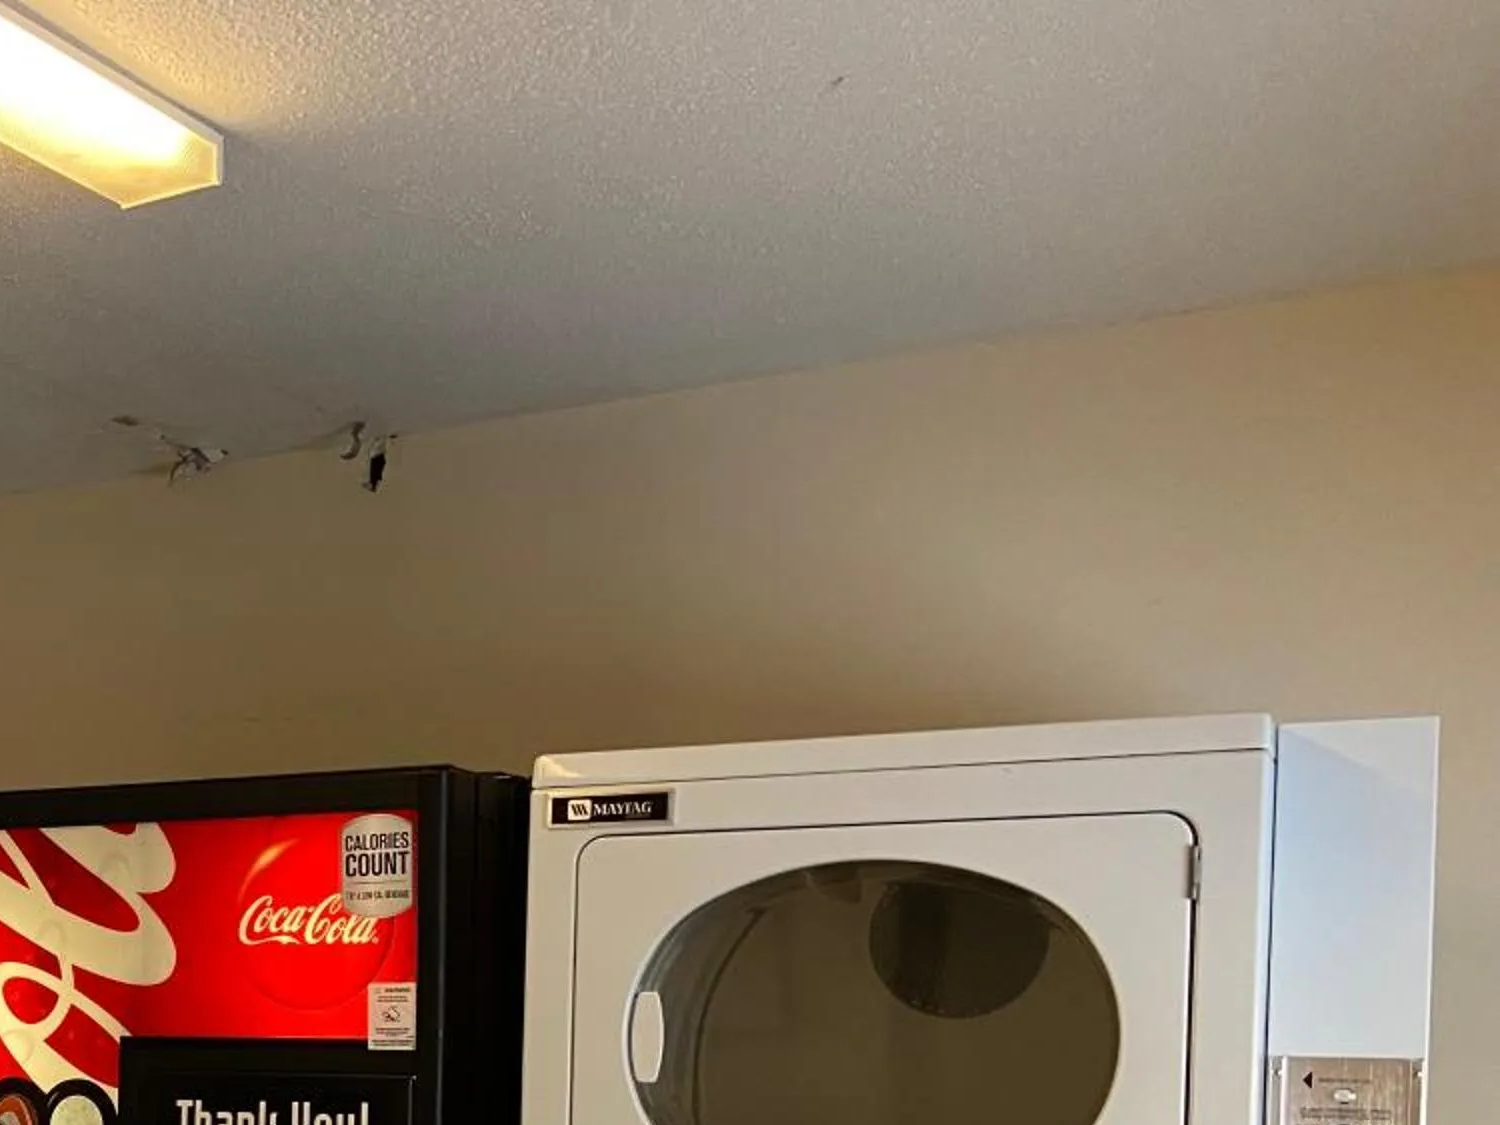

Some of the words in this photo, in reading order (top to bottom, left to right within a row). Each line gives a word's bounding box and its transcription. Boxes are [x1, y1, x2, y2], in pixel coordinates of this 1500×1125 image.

[593, 801, 653, 816] MAYTAG
[345, 831, 409, 852] CALORIES
[345, 851, 409, 877] COUNT
[238, 893, 379, 945] Coca-Cola
